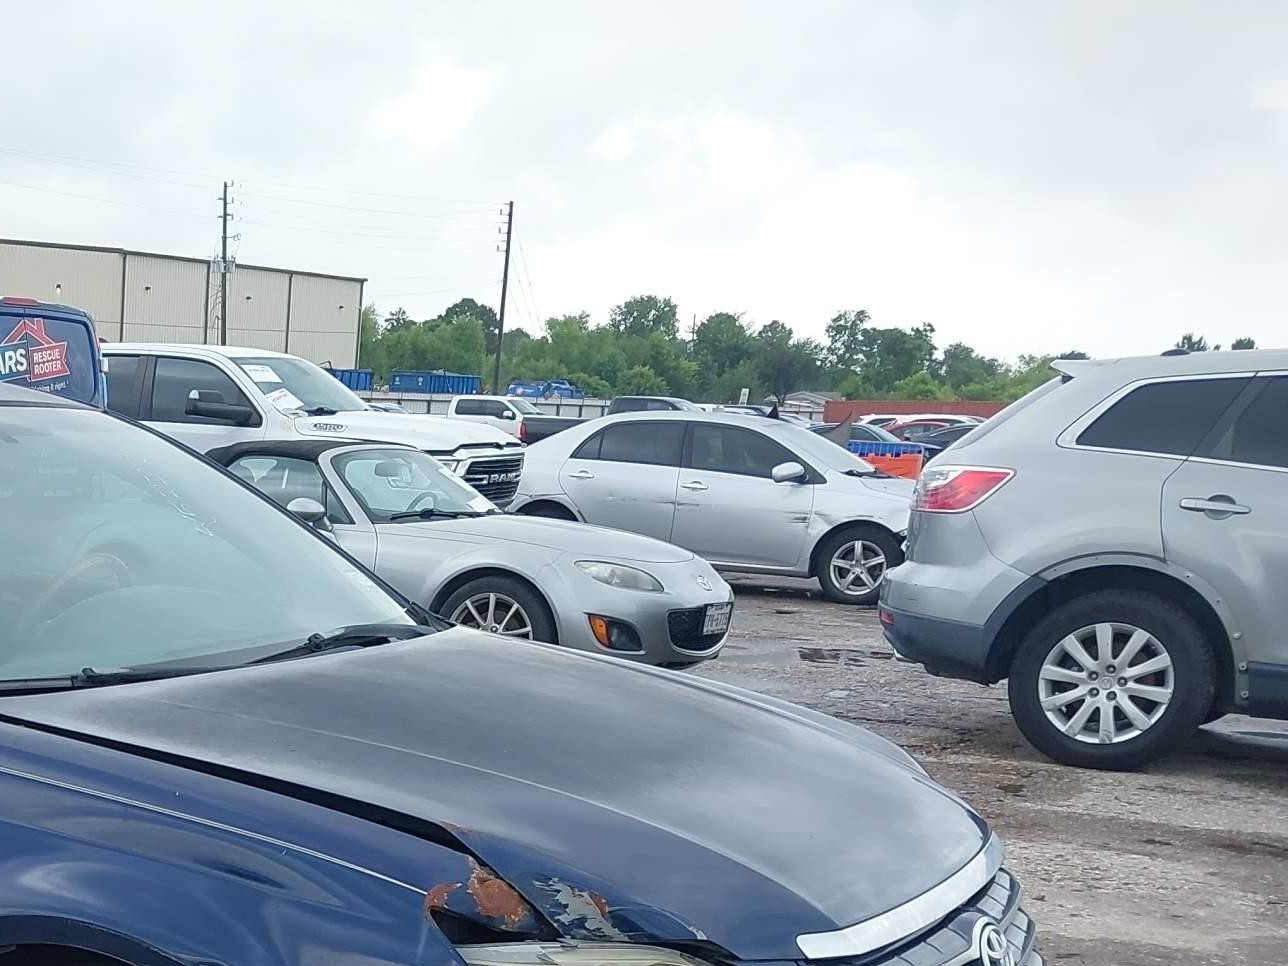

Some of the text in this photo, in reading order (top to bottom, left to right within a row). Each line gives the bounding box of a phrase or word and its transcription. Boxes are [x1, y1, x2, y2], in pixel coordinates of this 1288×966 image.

[33, 348, 61, 363] RESCUE
[34, 360, 62, 375] ROOTER
[489, 472, 516, 483] RAM
